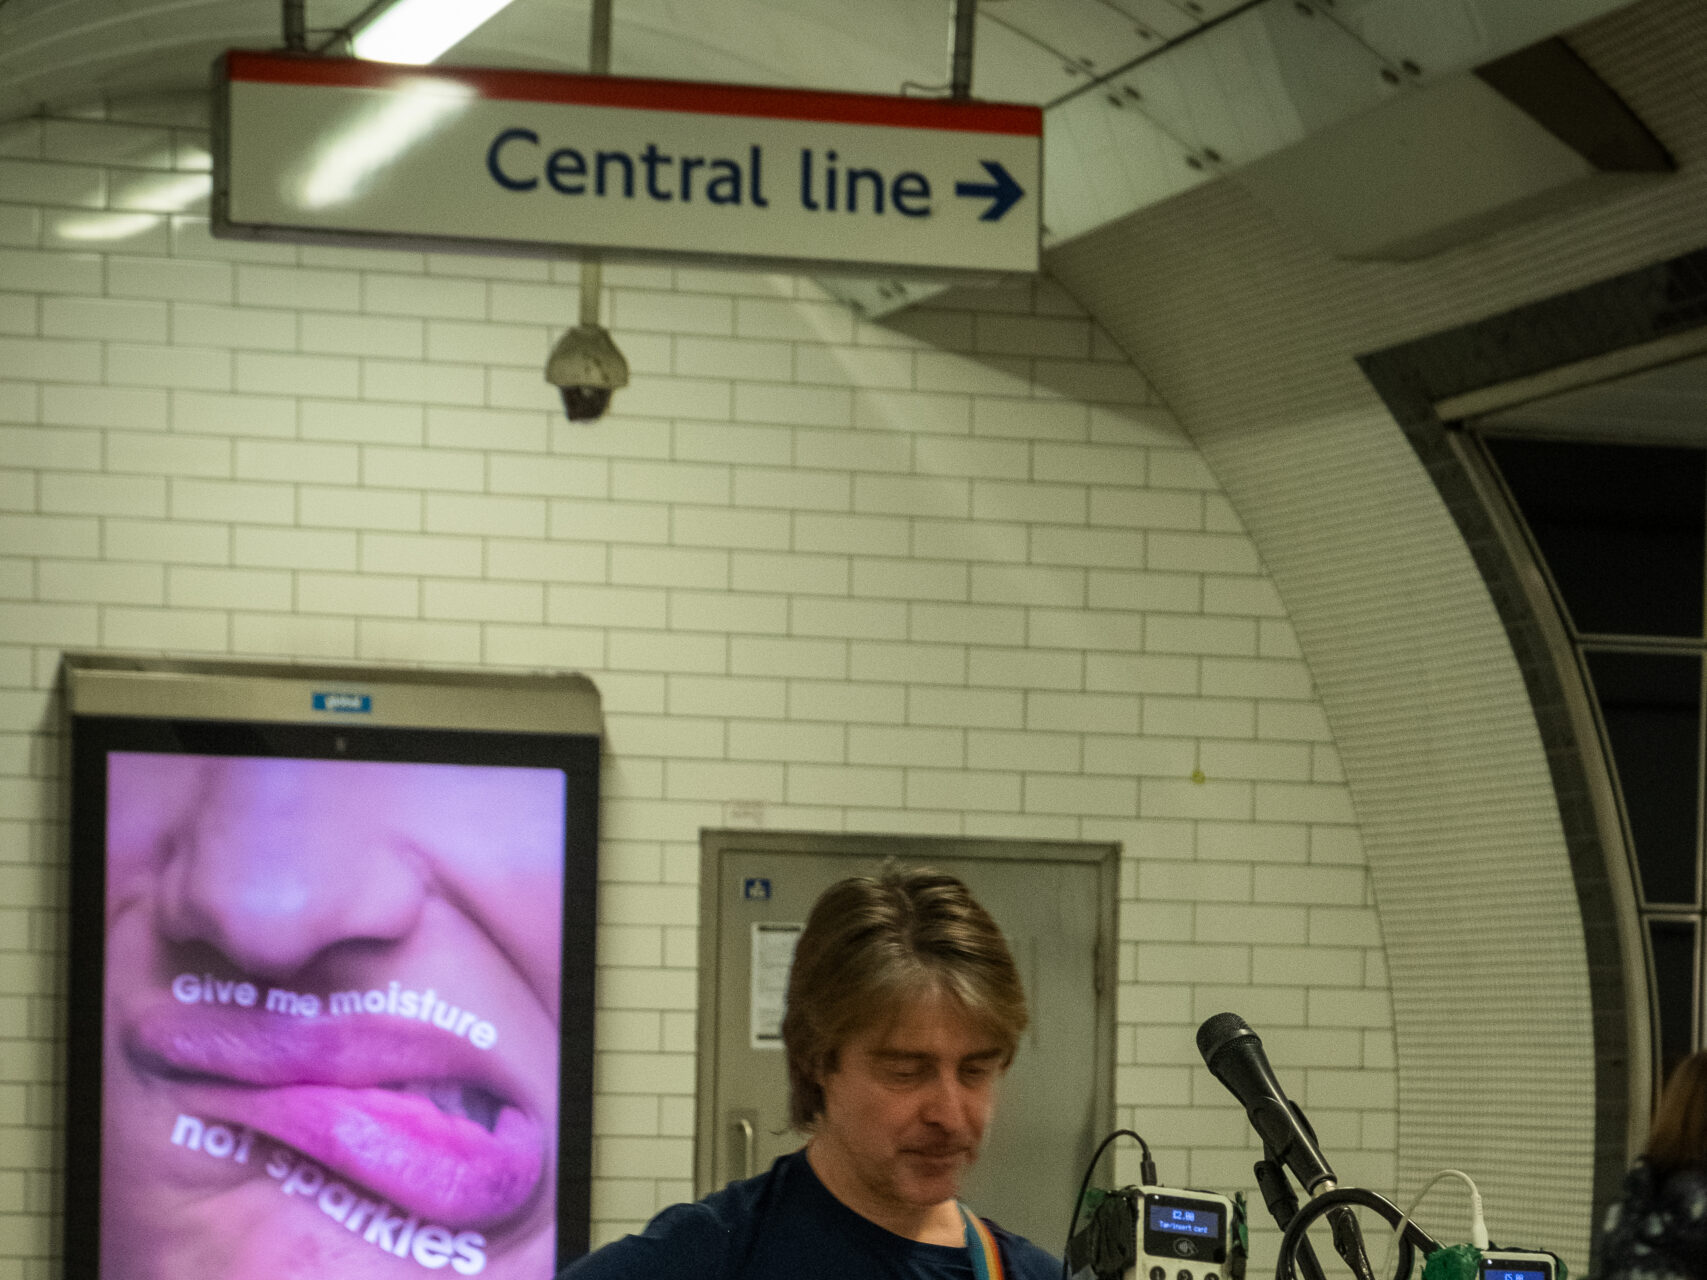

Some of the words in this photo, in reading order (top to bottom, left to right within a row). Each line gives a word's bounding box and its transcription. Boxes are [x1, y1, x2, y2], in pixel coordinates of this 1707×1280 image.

[487, 128, 768, 209] Central
[800, 149, 932, 218] line
[172, 971, 258, 1007] Give
[265, 987, 321, 1018] me
[329, 979, 499, 1051] moisture
[266, 1150, 488, 1277] sparkles
